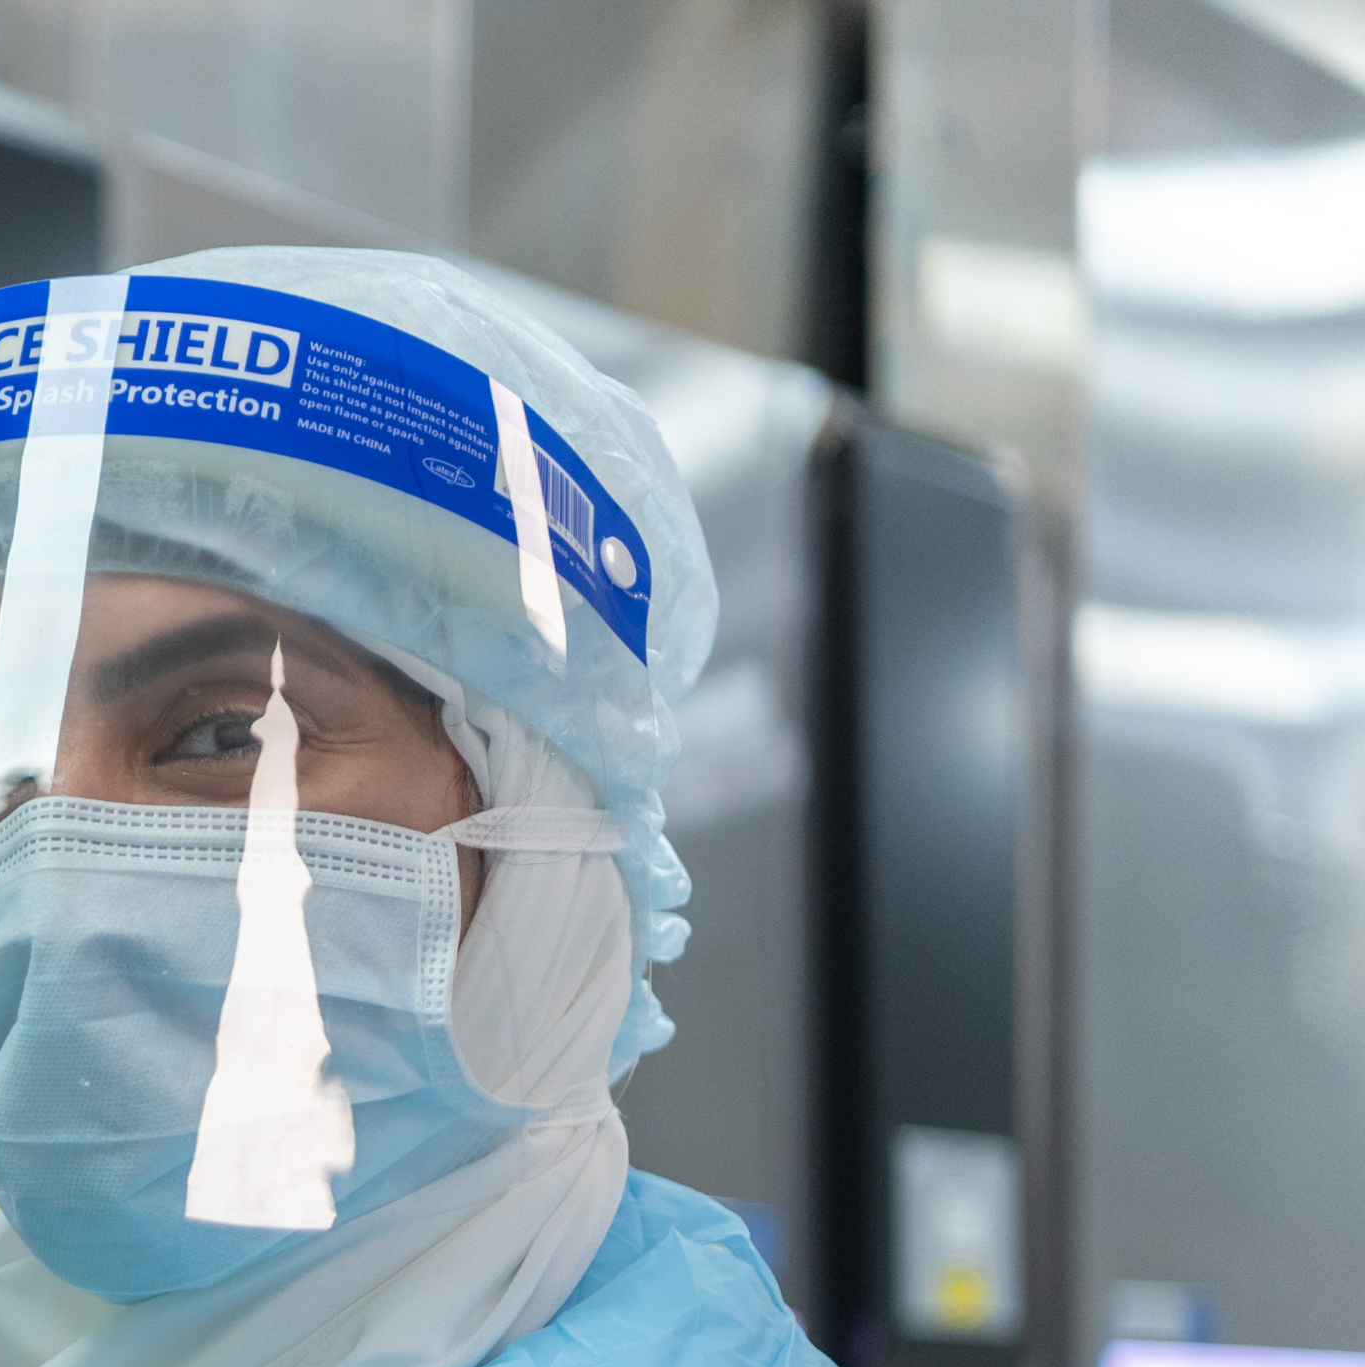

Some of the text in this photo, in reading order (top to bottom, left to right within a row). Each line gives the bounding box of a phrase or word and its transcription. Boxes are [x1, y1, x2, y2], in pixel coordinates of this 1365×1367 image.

[65, 317, 292, 378] SHIELD
[310, 341, 367, 367] Warning:
[110, 378, 282, 421] Protection
[305, 368, 497, 455] This shield is not impact resistant.
[307, 355, 488, 436] Use only against liquids or dust.
[297, 418, 392, 455] MADE IN CHINA
[299, 398, 425, 446] open flame or sparks
[302, 381, 488, 463] Do not use as protection against
[429, 460, 455, 479] Latex
